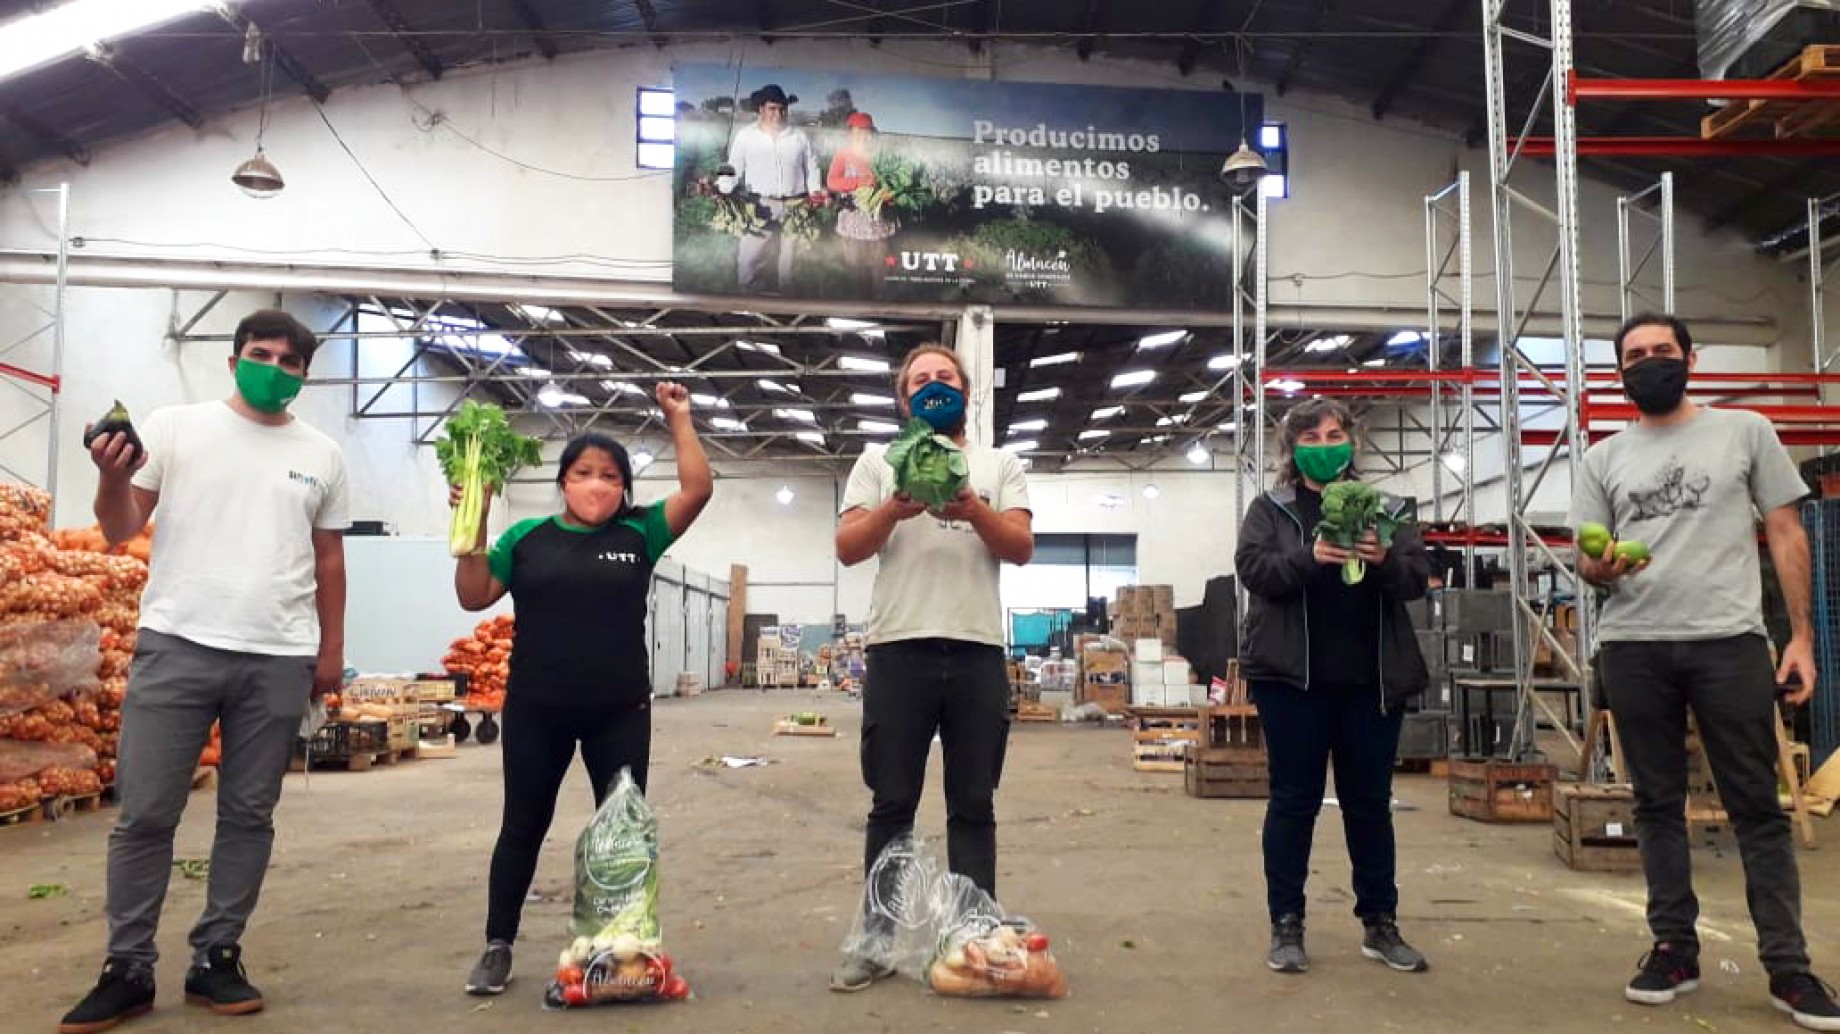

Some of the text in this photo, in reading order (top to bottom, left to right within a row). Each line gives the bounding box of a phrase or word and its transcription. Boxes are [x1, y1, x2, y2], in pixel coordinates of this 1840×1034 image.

[973, 119, 1161, 153] Producimos
[973, 150, 1131, 180] alimentos
[973, 183, 1210, 214] para el pueblo.
[900, 251, 959, 273] UTT
[605, 551, 636, 563] UTT
